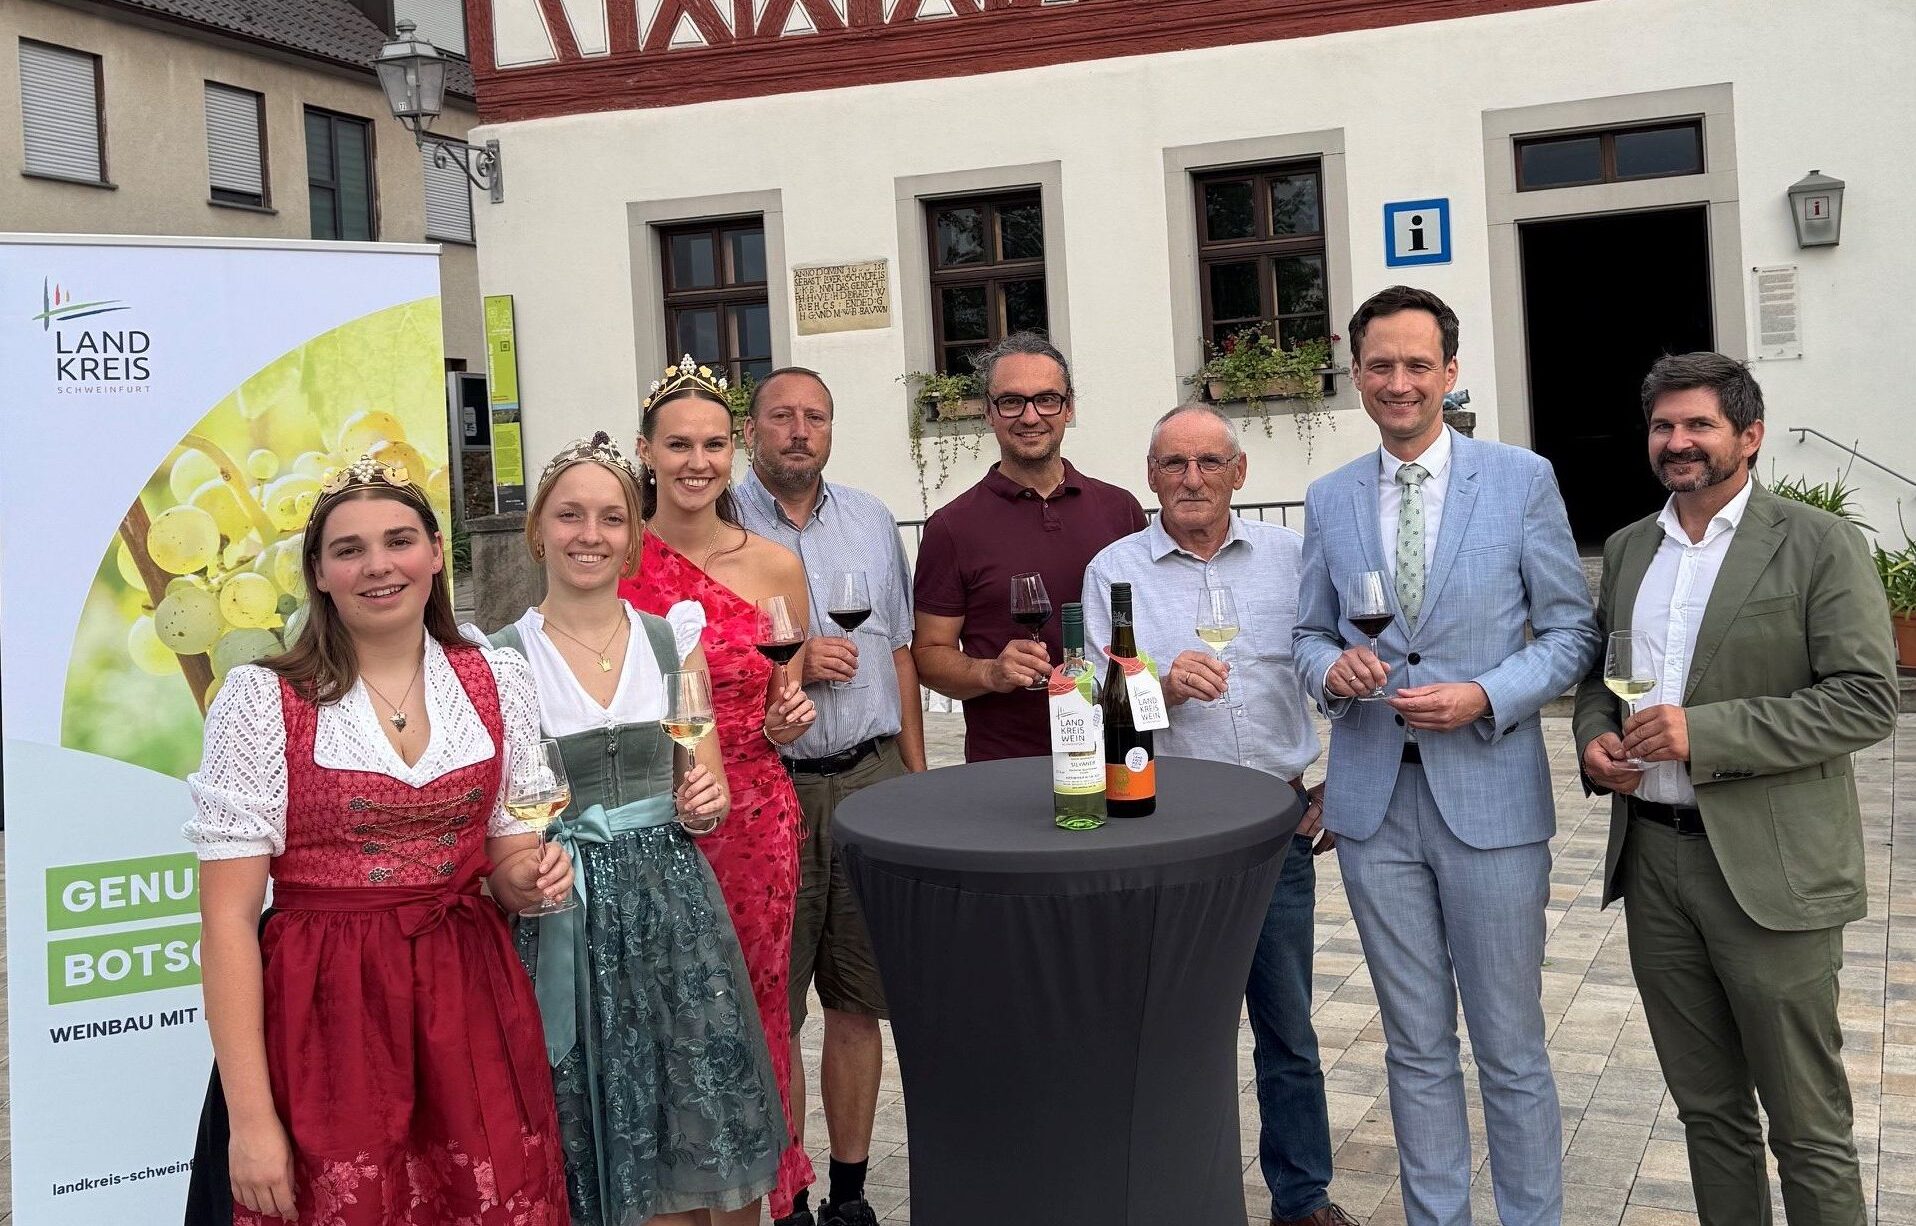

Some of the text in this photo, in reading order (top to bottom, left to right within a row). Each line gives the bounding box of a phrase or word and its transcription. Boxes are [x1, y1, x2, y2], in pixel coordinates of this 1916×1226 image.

[1813, 200, 1821, 216] i
[1408, 214, 1429, 252] i
[56, 331, 150, 354] LAND
[57, 357, 151, 381] KREIS
[57, 386, 151, 394] SCHWEINFURT
[1139, 704, 1159, 714] KREIS
[1060, 719, 1084, 727] LAND
[1140, 712, 1161, 721] WEIN
[1060, 726, 1085, 735] KREIS
[1061, 735, 1085, 743] WEIN
[64, 939, 201, 987] BOTS
[50, 1007, 198, 1043] WEINBAU MIT
